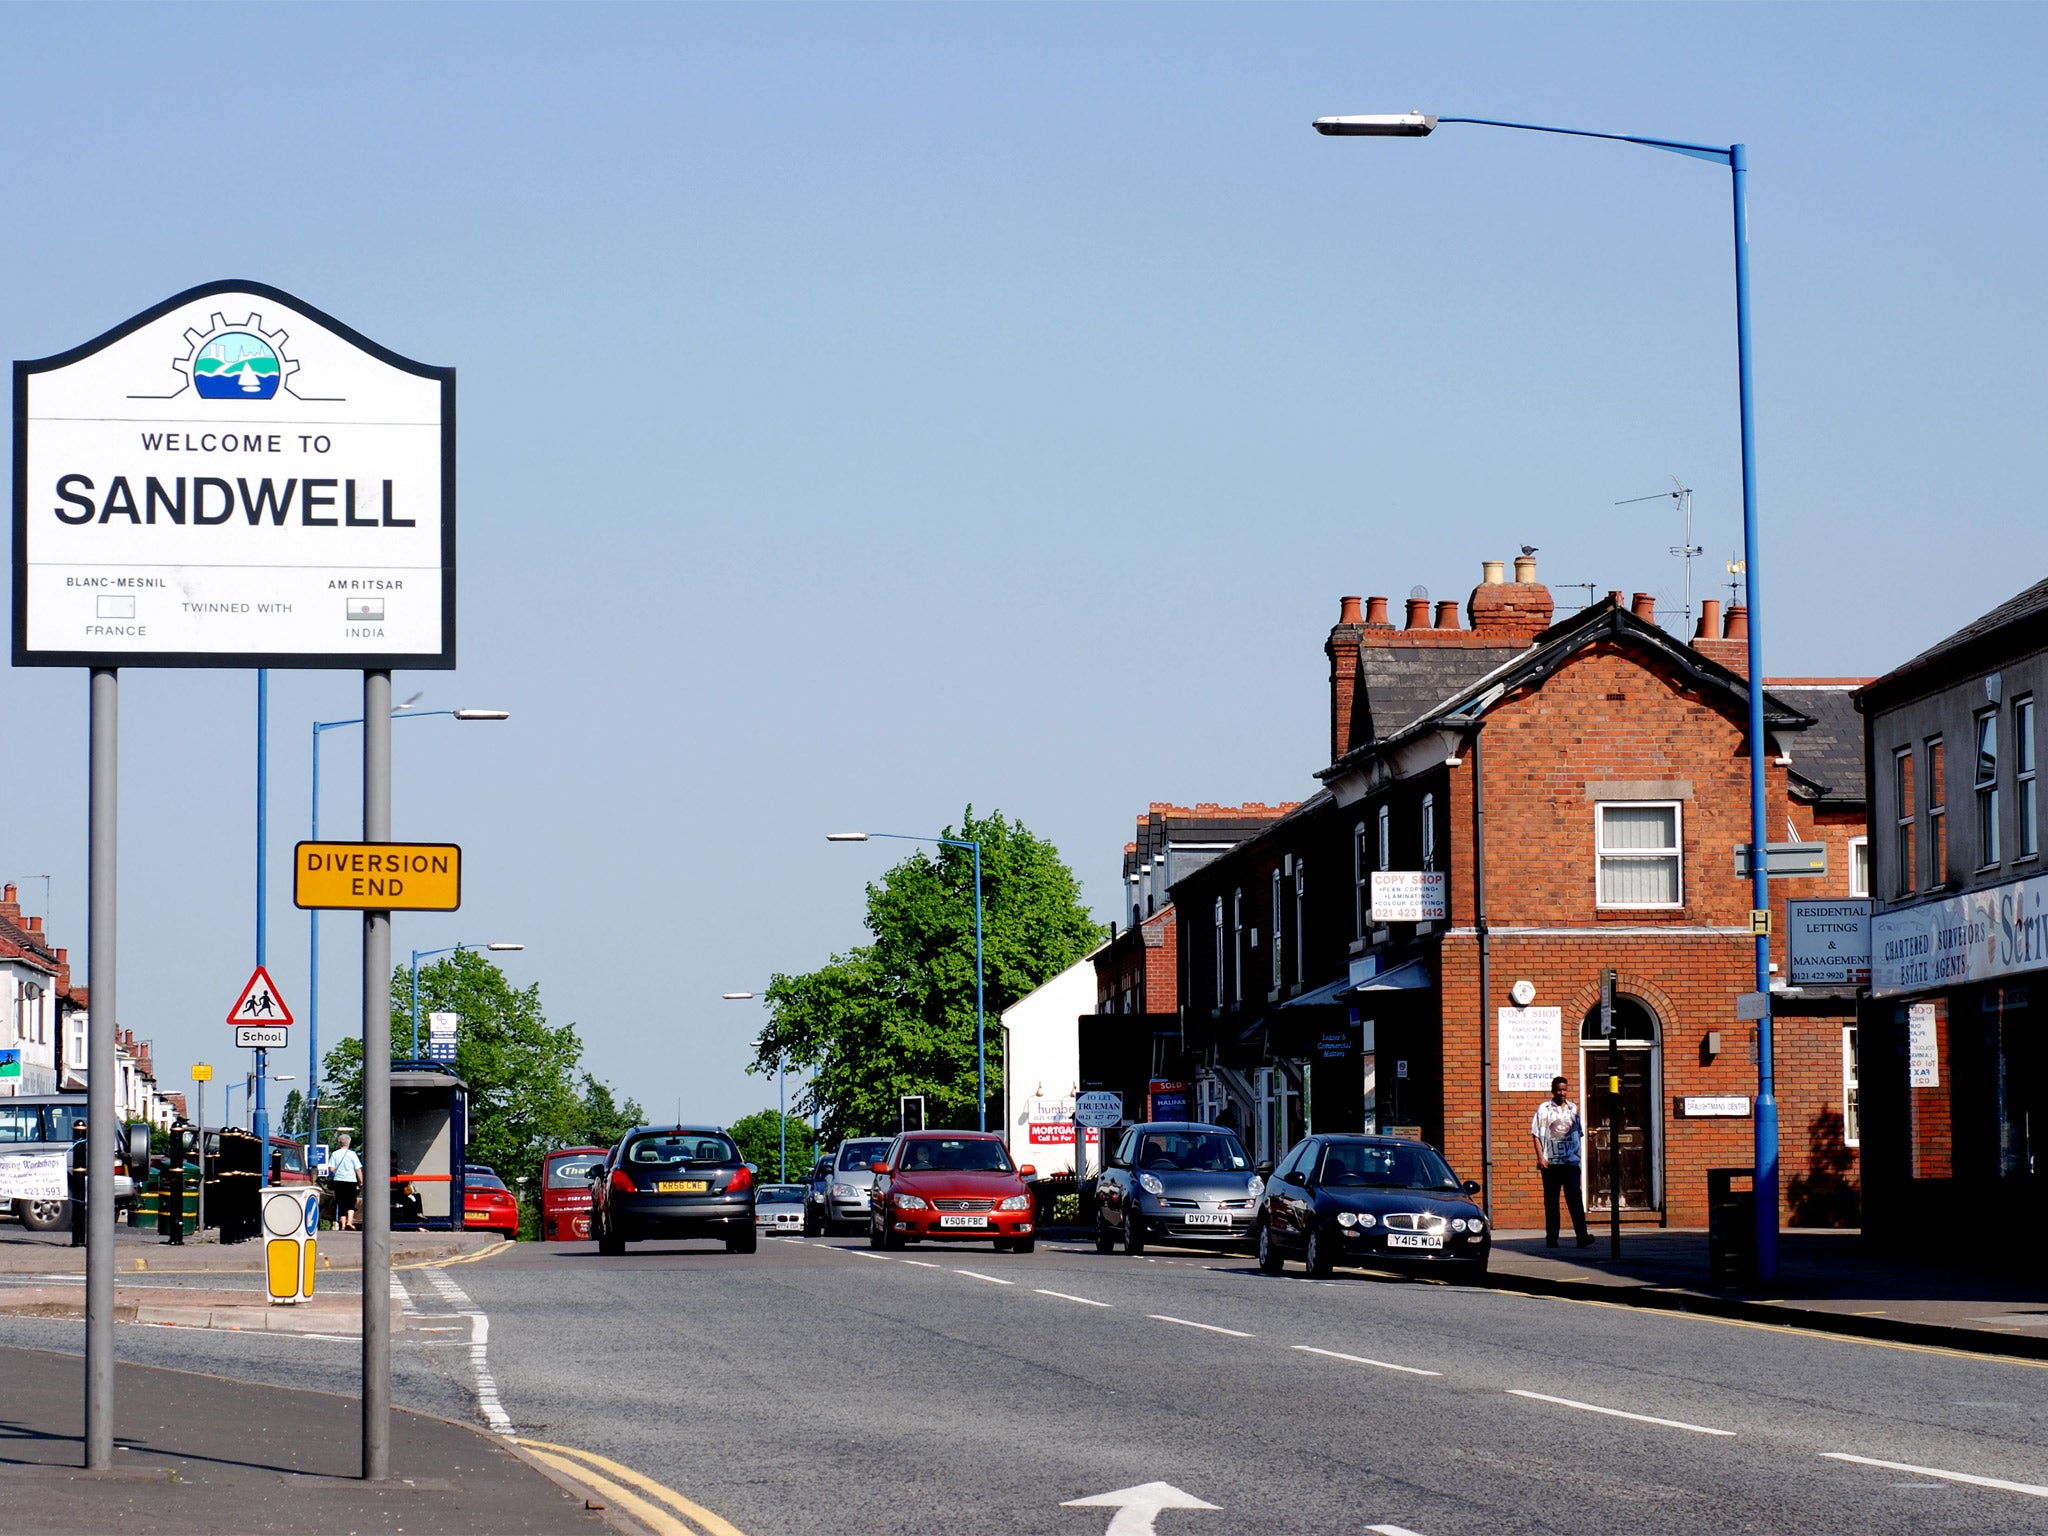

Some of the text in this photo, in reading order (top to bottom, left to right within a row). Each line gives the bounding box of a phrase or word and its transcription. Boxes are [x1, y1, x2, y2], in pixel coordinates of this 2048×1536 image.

[141, 432, 332, 453] WELCOME TO
[53, 473, 417, 528] SANDWELL
[66, 577, 167, 588] BLANC-MESNIL
[328, 580, 404, 590] AMRITSAR
[182, 602, 293, 613] TWINNED WITH
[85, 625, 147, 636] FRANCE
[345, 628, 385, 638] INDIA
[307, 853, 448, 873] DIVERSION
[1374, 875, 1442, 885] COPY SHOP
[352, 878, 404, 896] END
[1375, 907, 1444, 917] 021 423 1412
[1796, 907, 1867, 917] RESIDENTIAL
[1753, 912, 1768, 932] H
[1806, 923, 1858, 933] LETTINGS
[1827, 940, 1837, 950] &
[1884, 933, 1929, 961] CHARTERED
[1937, 921, 1985, 951] SURVEYORS
[1793, 955, 1872, 966] MANAGEMENT
[1900, 953, 1966, 986] ESTATE AGENTS
[1792, 972, 1809, 980] 0121
[1811, 972, 1825, 980] 422
[1826, 971, 1844, 980] 9920
[1501, 1009, 1559, 1018] COPY SHOP
[242, 1031, 282, 1042] School
[1160, 1081, 1182, 1090] SOLD
[1078, 1102, 1121, 1110] TRUEMAN
[1727, 1102, 1748, 1110] CENTRE
[967, 1217, 984, 1225] FBC
[1189, 1214, 1229, 1223] DV07 PVA
[1394, 1235, 1442, 1247] Y415 WOA
